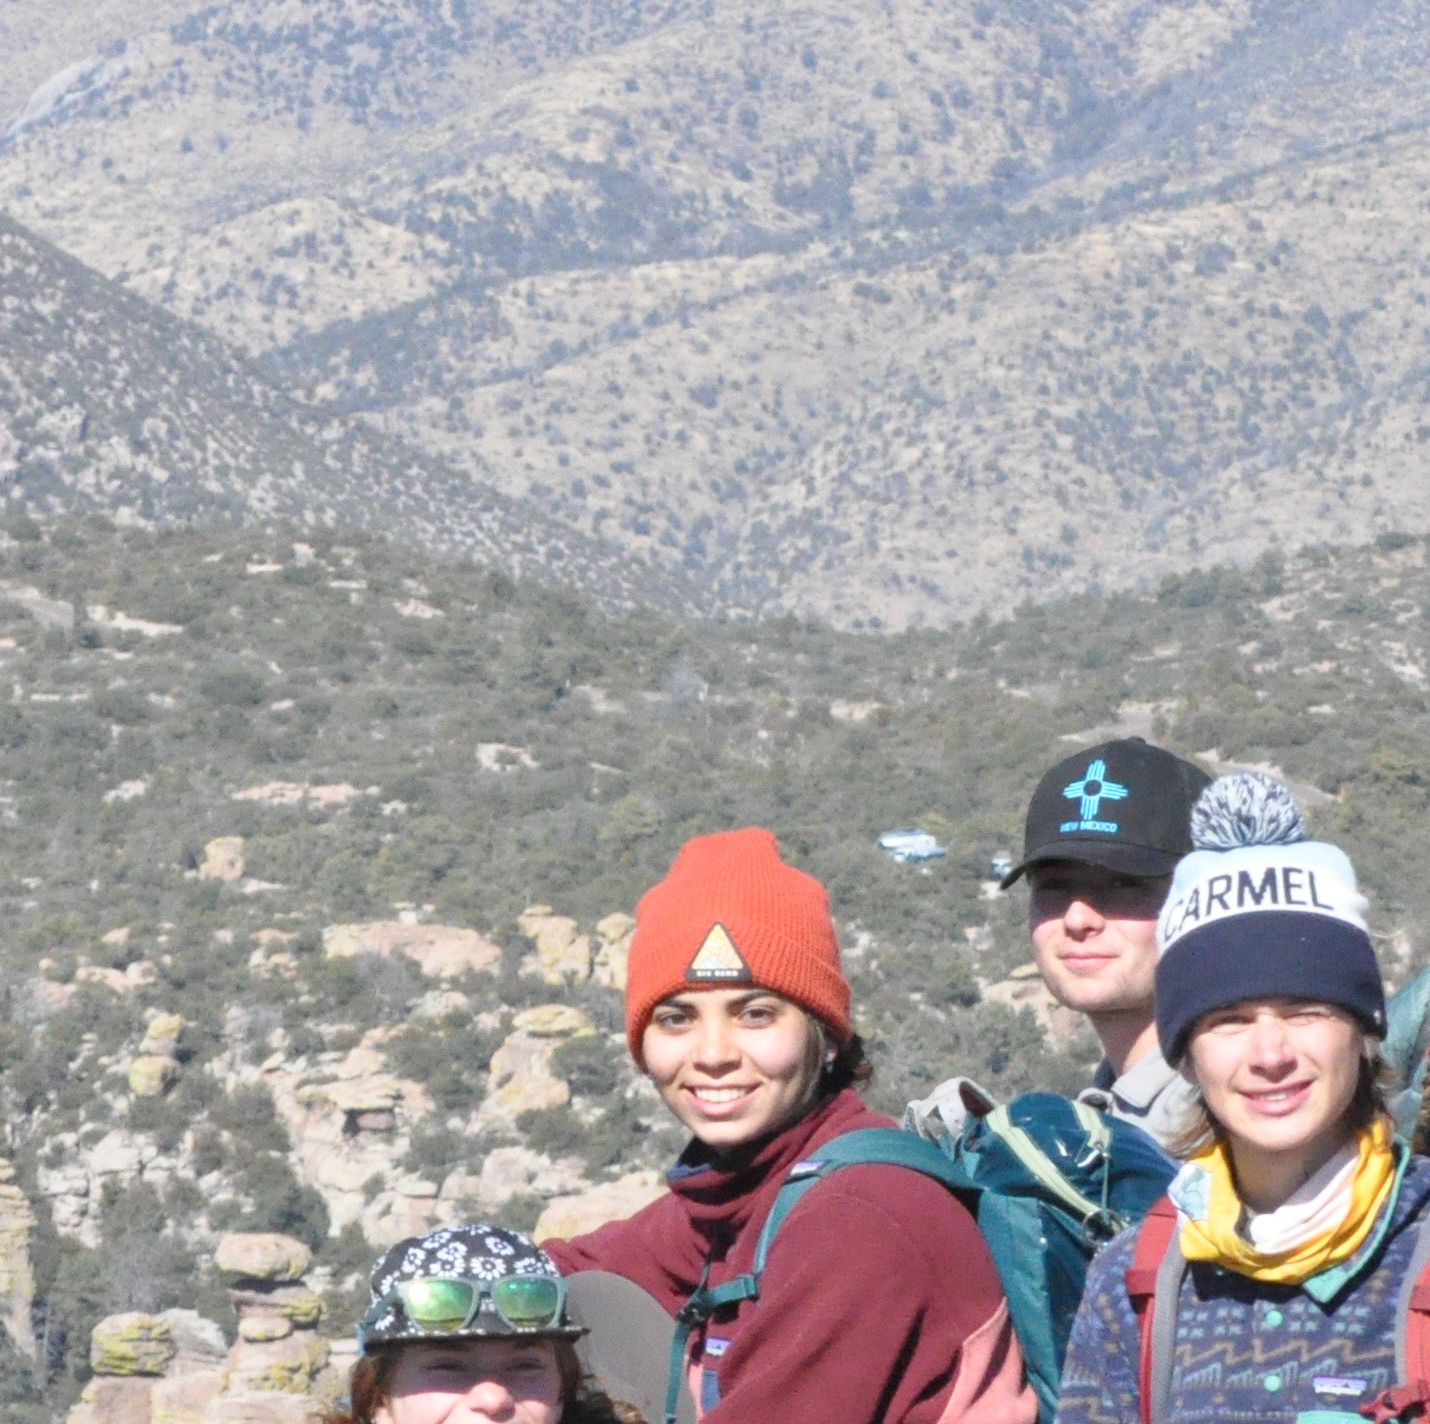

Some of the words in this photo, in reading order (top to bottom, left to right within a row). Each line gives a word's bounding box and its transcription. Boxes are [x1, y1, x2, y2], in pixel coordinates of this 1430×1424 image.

[1059, 821, 1079, 833] NEW
[1079, 820, 1118, 833] MEXICO
[1164, 866, 1334, 943] CARMEL
